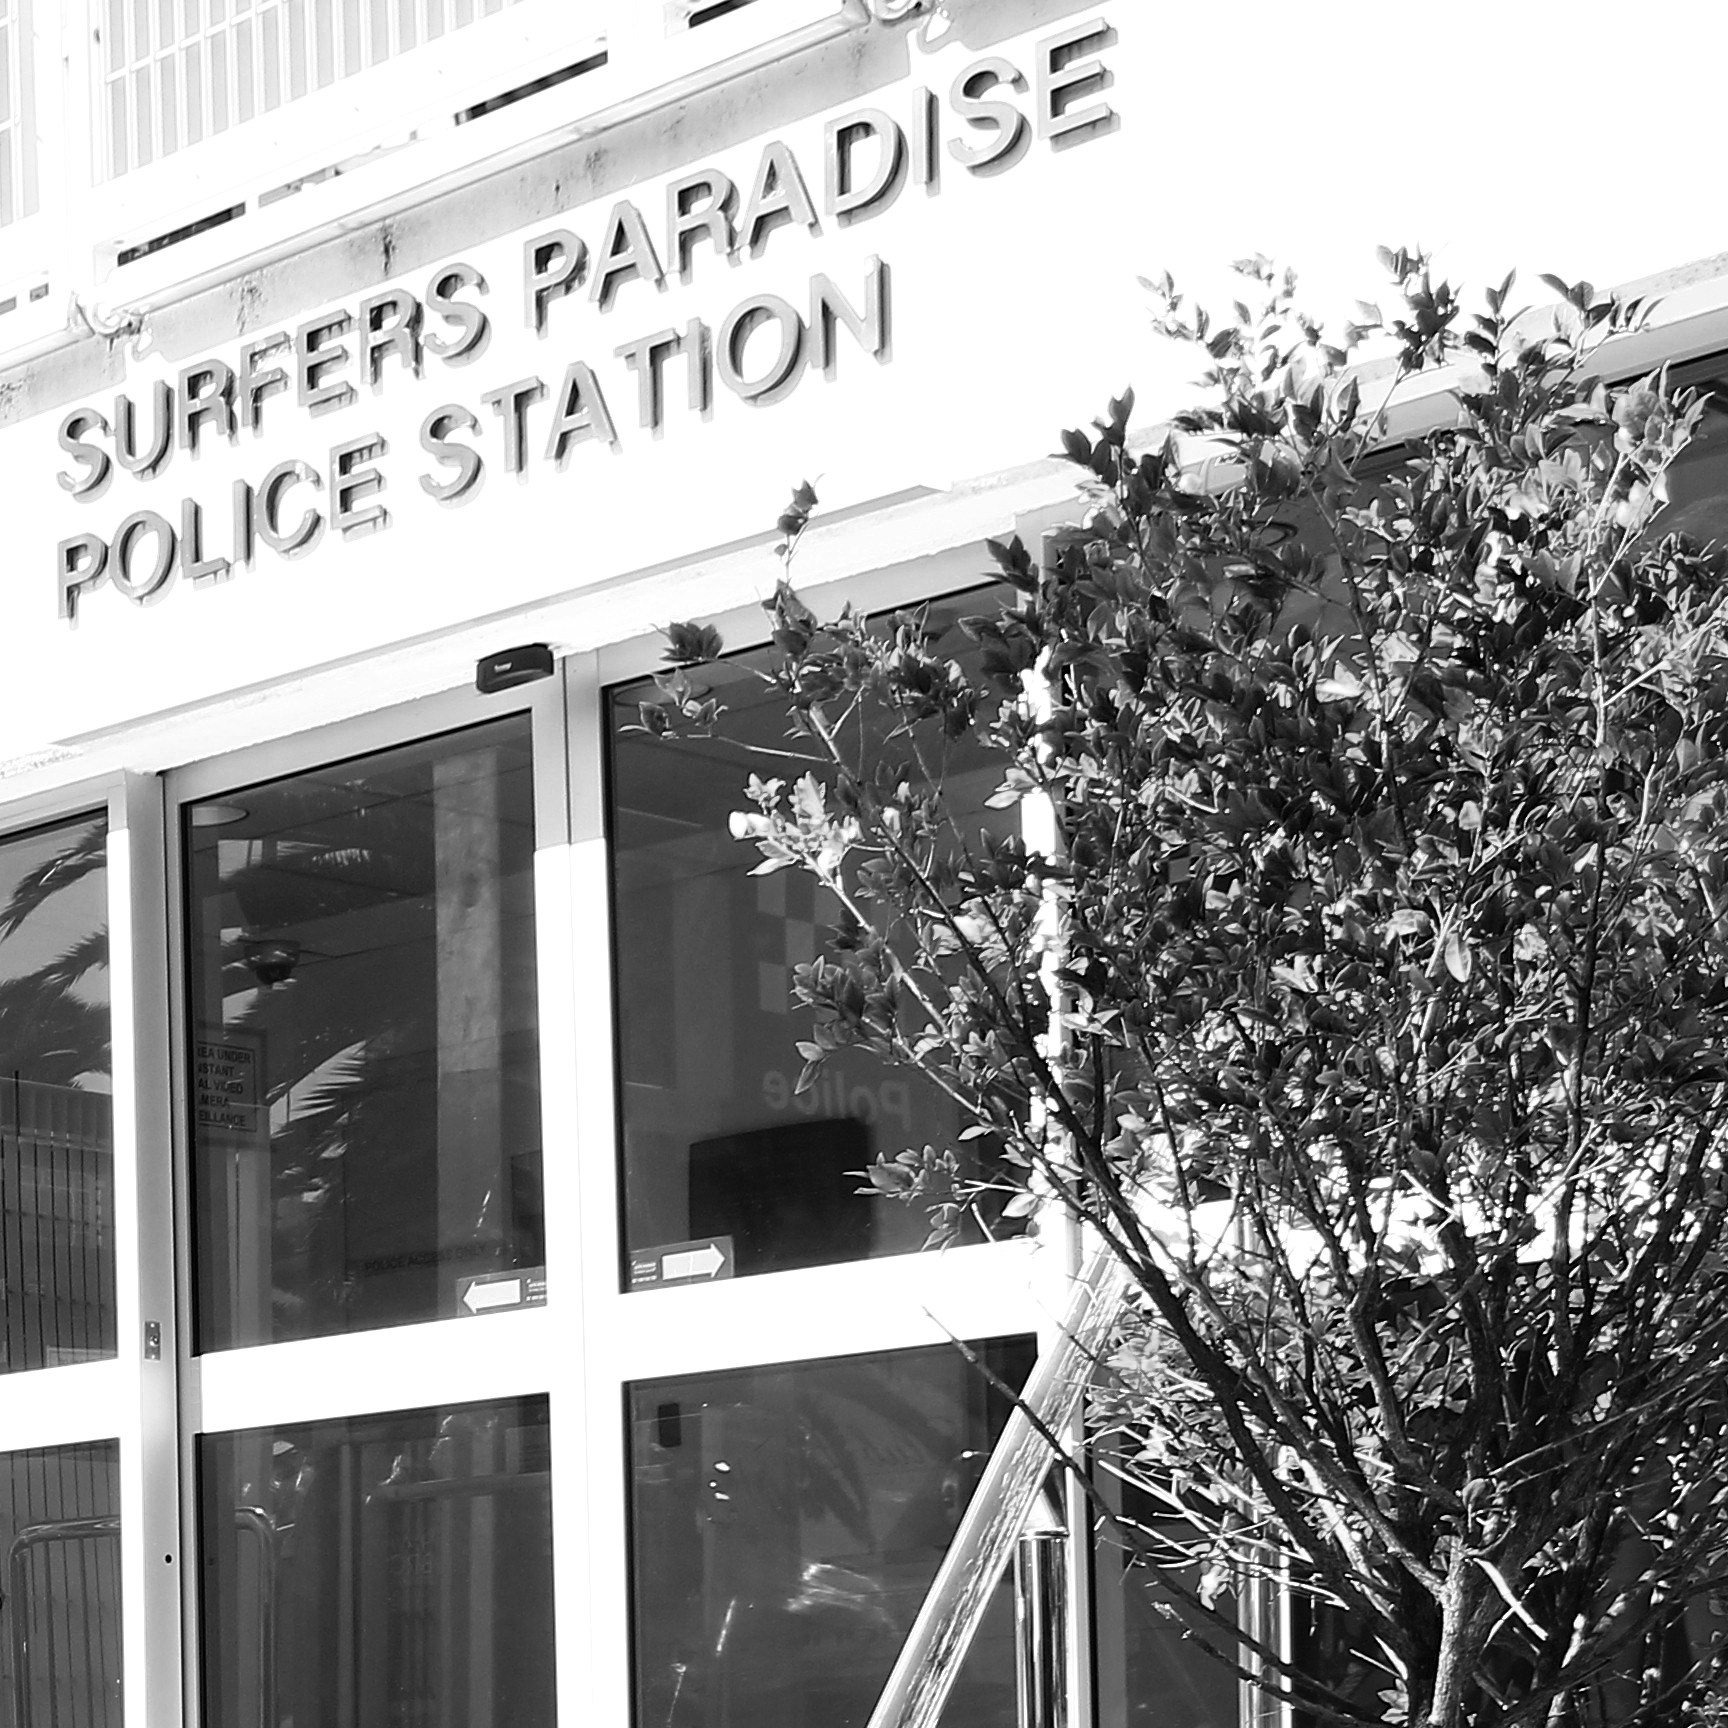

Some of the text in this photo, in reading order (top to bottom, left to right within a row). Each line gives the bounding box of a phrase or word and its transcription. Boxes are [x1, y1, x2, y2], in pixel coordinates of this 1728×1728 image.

[57, 17, 1120, 502] SURFERS PARADISE
[58, 253, 893, 629] POLICE STATION
[217, 1048, 251, 1064] UNDER
